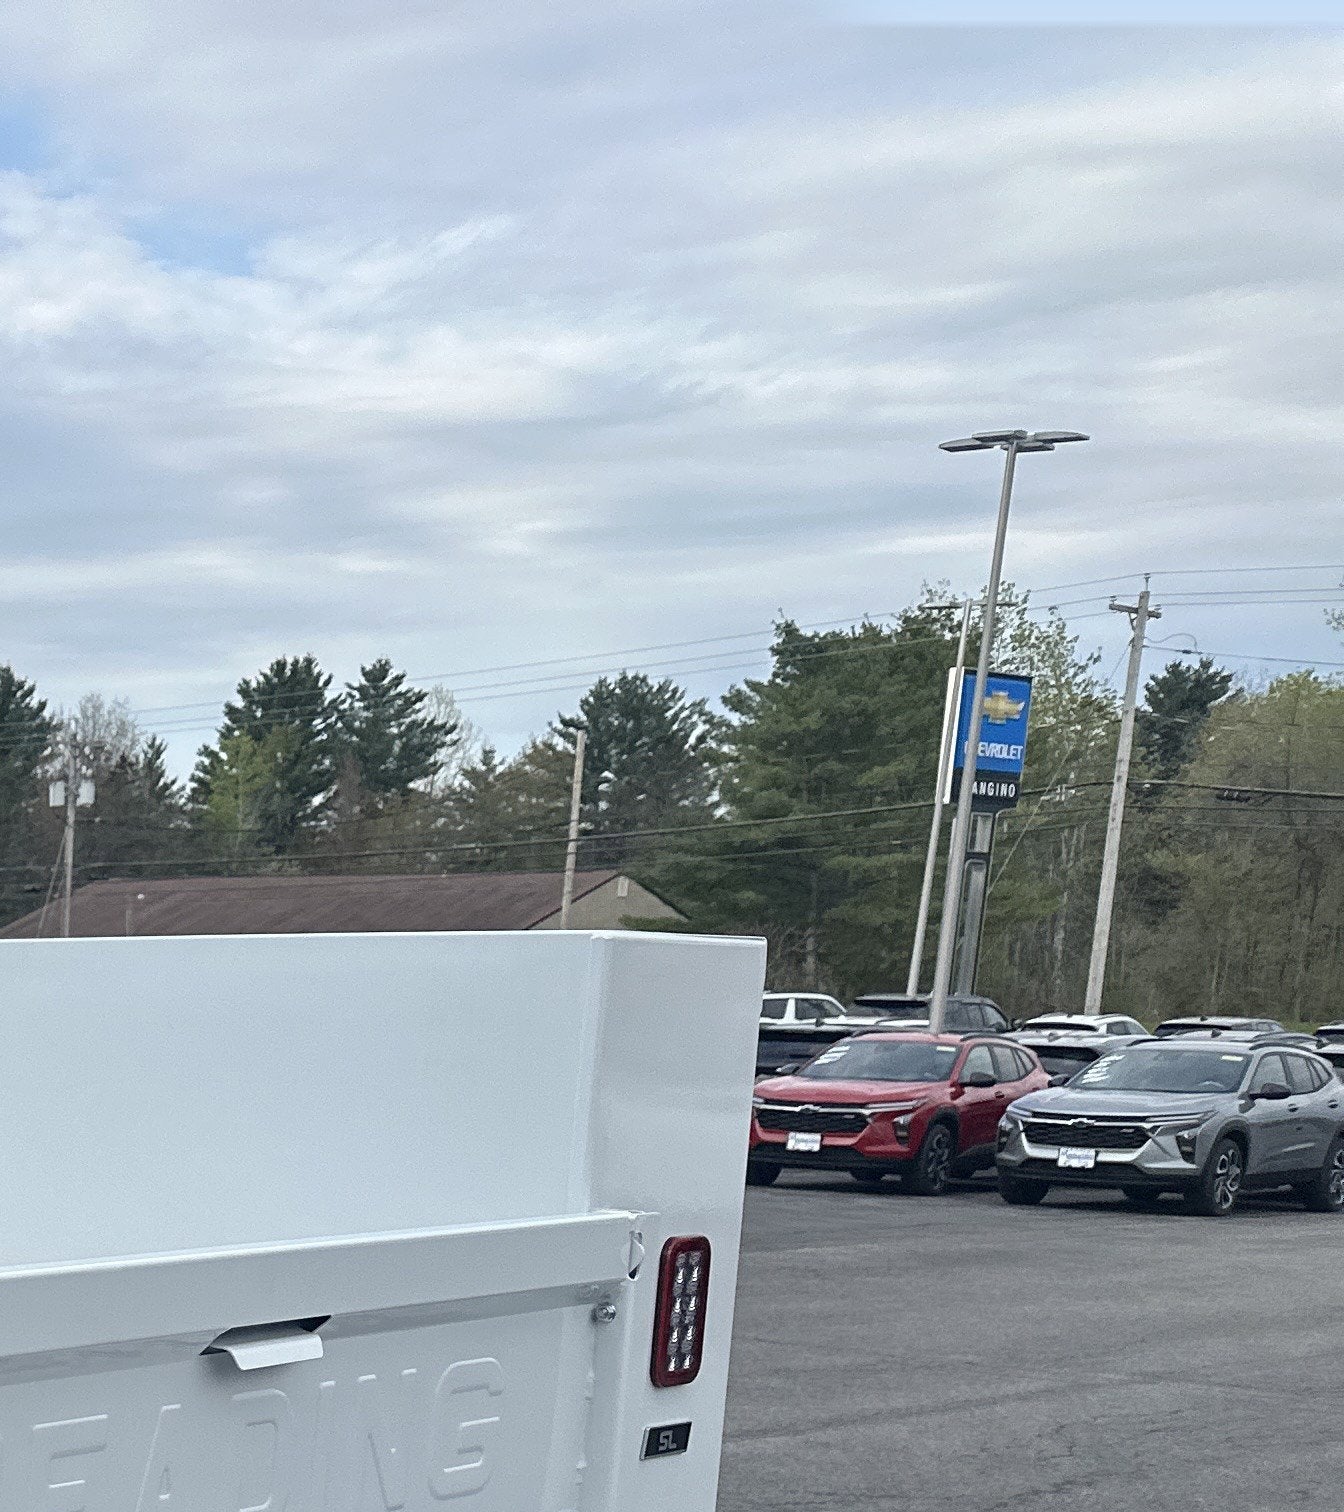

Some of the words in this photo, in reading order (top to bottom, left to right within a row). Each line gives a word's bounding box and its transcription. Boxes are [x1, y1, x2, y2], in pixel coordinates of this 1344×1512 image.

[964, 741, 1023, 760] EVROLET
[971, 781, 1016, 797] ANGINO
[658, 1429, 677, 1451] SL
